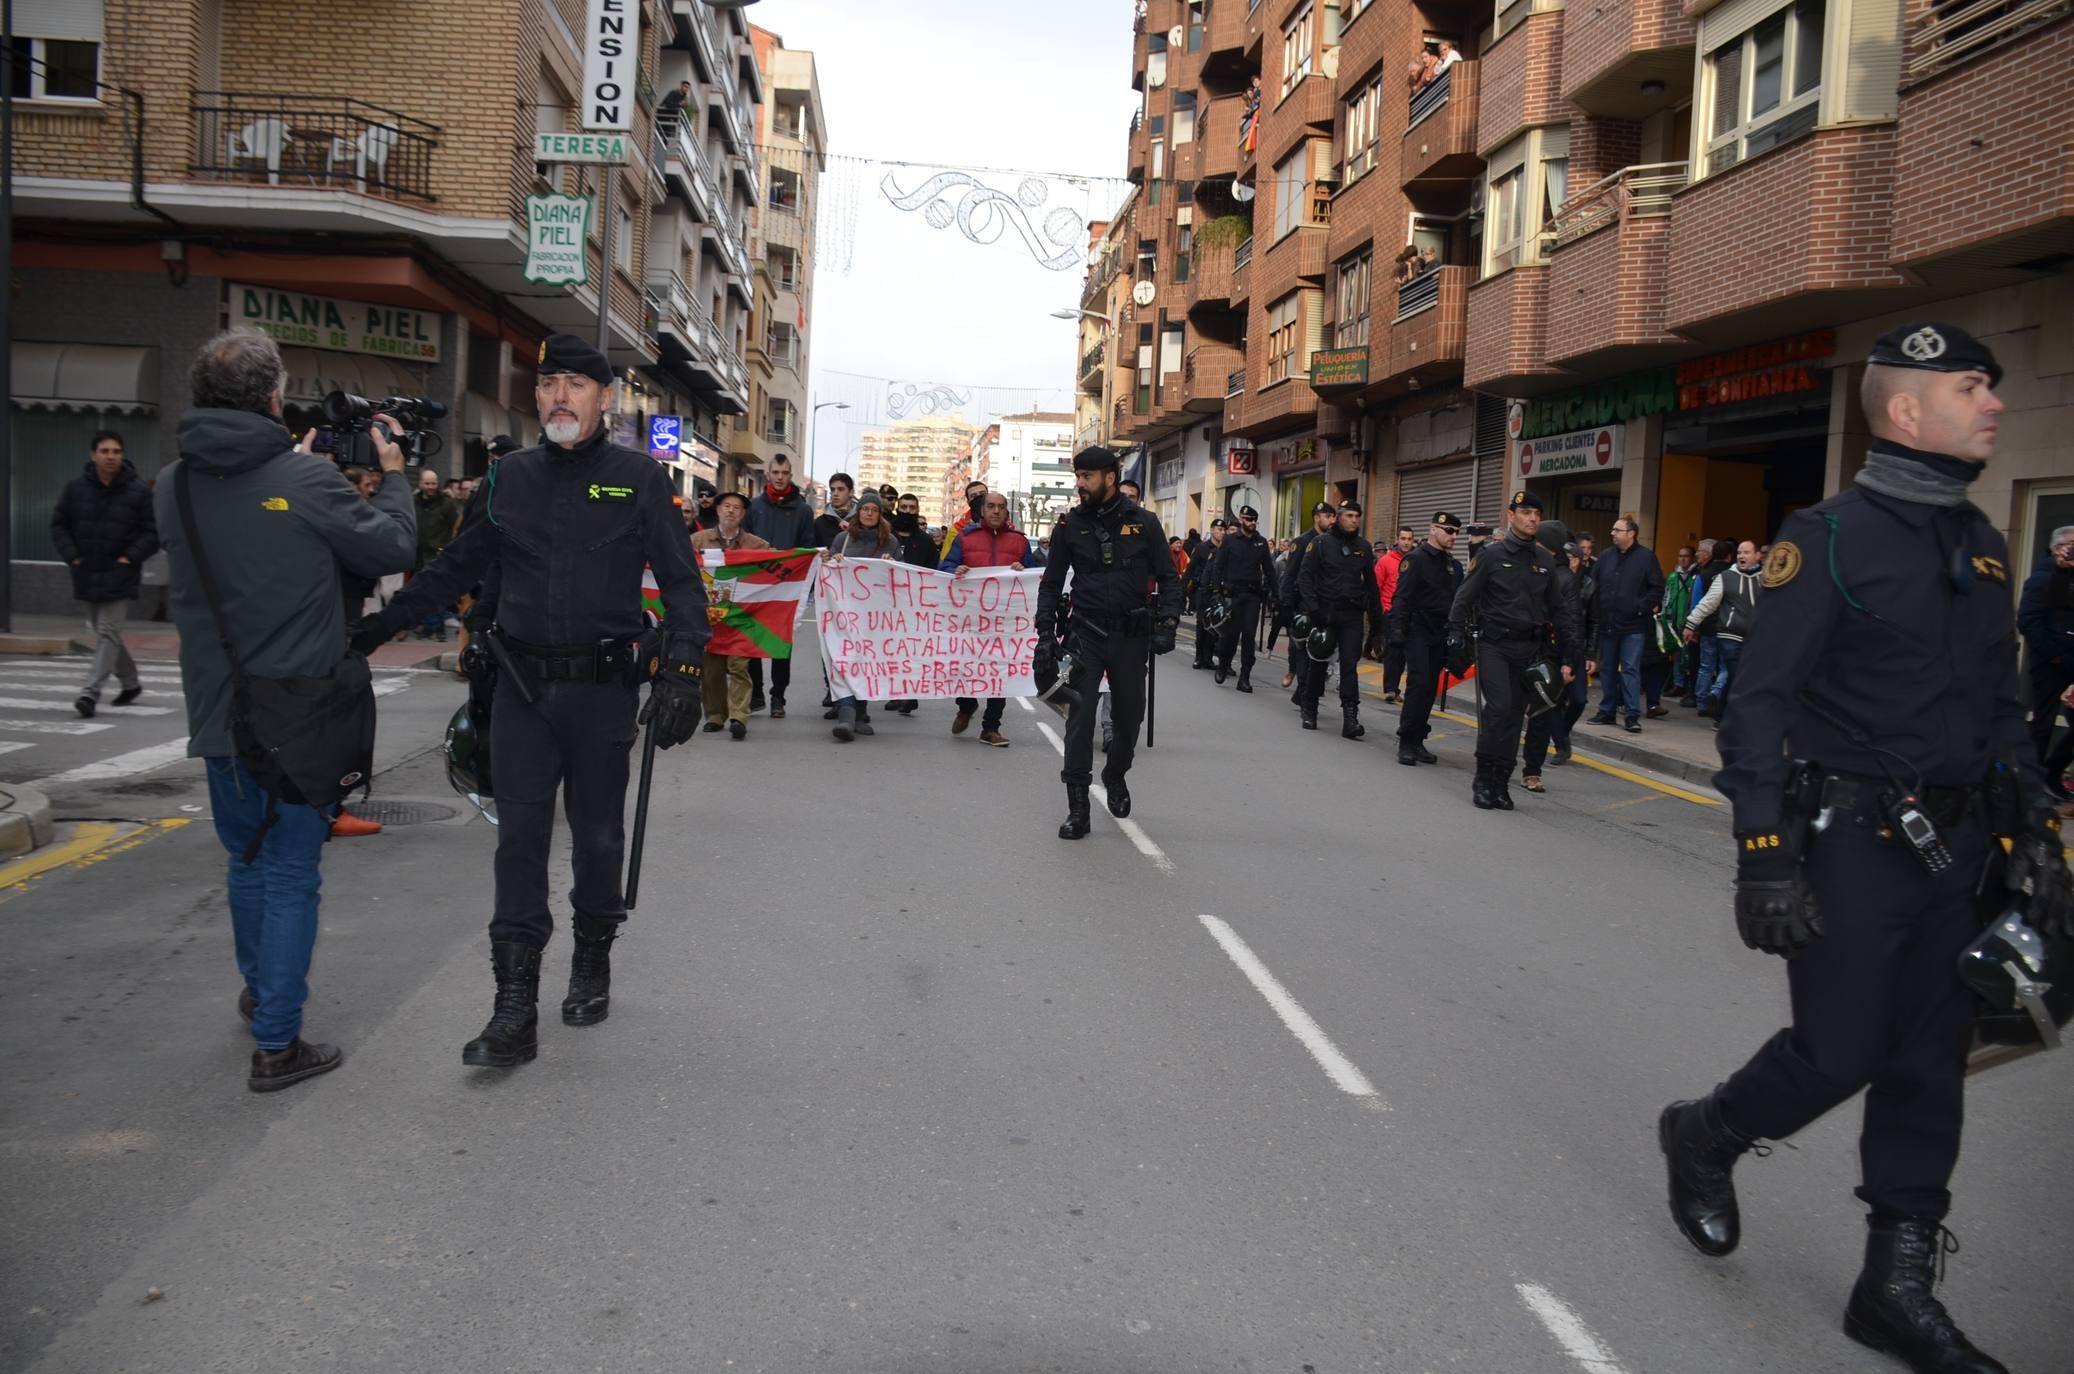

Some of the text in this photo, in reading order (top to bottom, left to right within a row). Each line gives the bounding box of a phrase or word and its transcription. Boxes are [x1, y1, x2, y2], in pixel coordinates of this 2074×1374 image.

[595, 0, 624, 123] ENSION
[540, 135, 624, 158] TERESA
[534, 203, 581, 223] DIANA
[540, 226, 576, 245] PIEL
[536, 264, 575, 274] PROPIA
[243, 289, 429, 341] DIANA PIEL
[329, 331, 349, 347] DE
[362, 335, 419, 355] FABRICA
[1706, 366, 1817, 405] CONFIANZA
[1523, 369, 1674, 438] MERCADONA
[1534, 432, 1595, 455] PARKING CLIENTES
[1540, 454, 1587, 472] MERCADONA
[823, 610, 859, 634] POR
[868, 610, 906, 632] UNA
[843, 639, 876, 659] POR
[922, 660, 1000, 682] PRESOS
[1746, 834, 1780, 850] ARS
